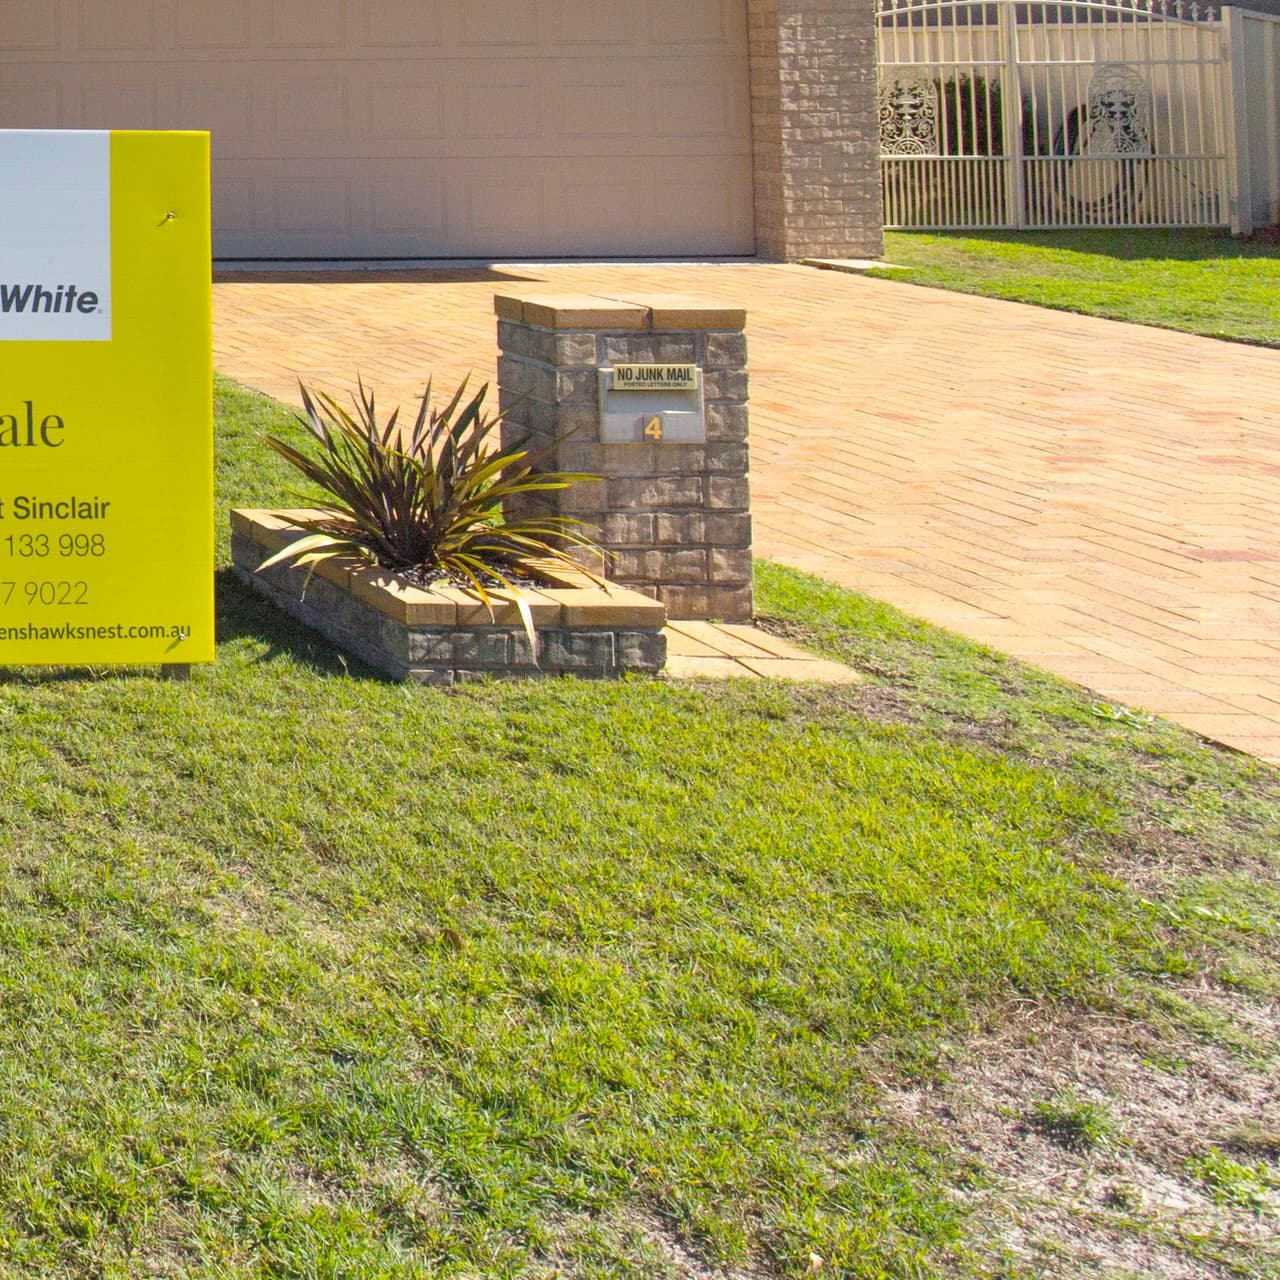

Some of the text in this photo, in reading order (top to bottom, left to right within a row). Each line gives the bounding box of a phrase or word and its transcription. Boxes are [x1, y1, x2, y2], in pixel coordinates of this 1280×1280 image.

[617, 368, 693, 381] NO JUNK MAIL
[644, 416, 662, 440] 4
[13, 496, 111, 520] Sinclair
[5, 534, 49, 557] 133
[58, 534, 106, 557] 998
[24, 581, 89, 606] 9022
